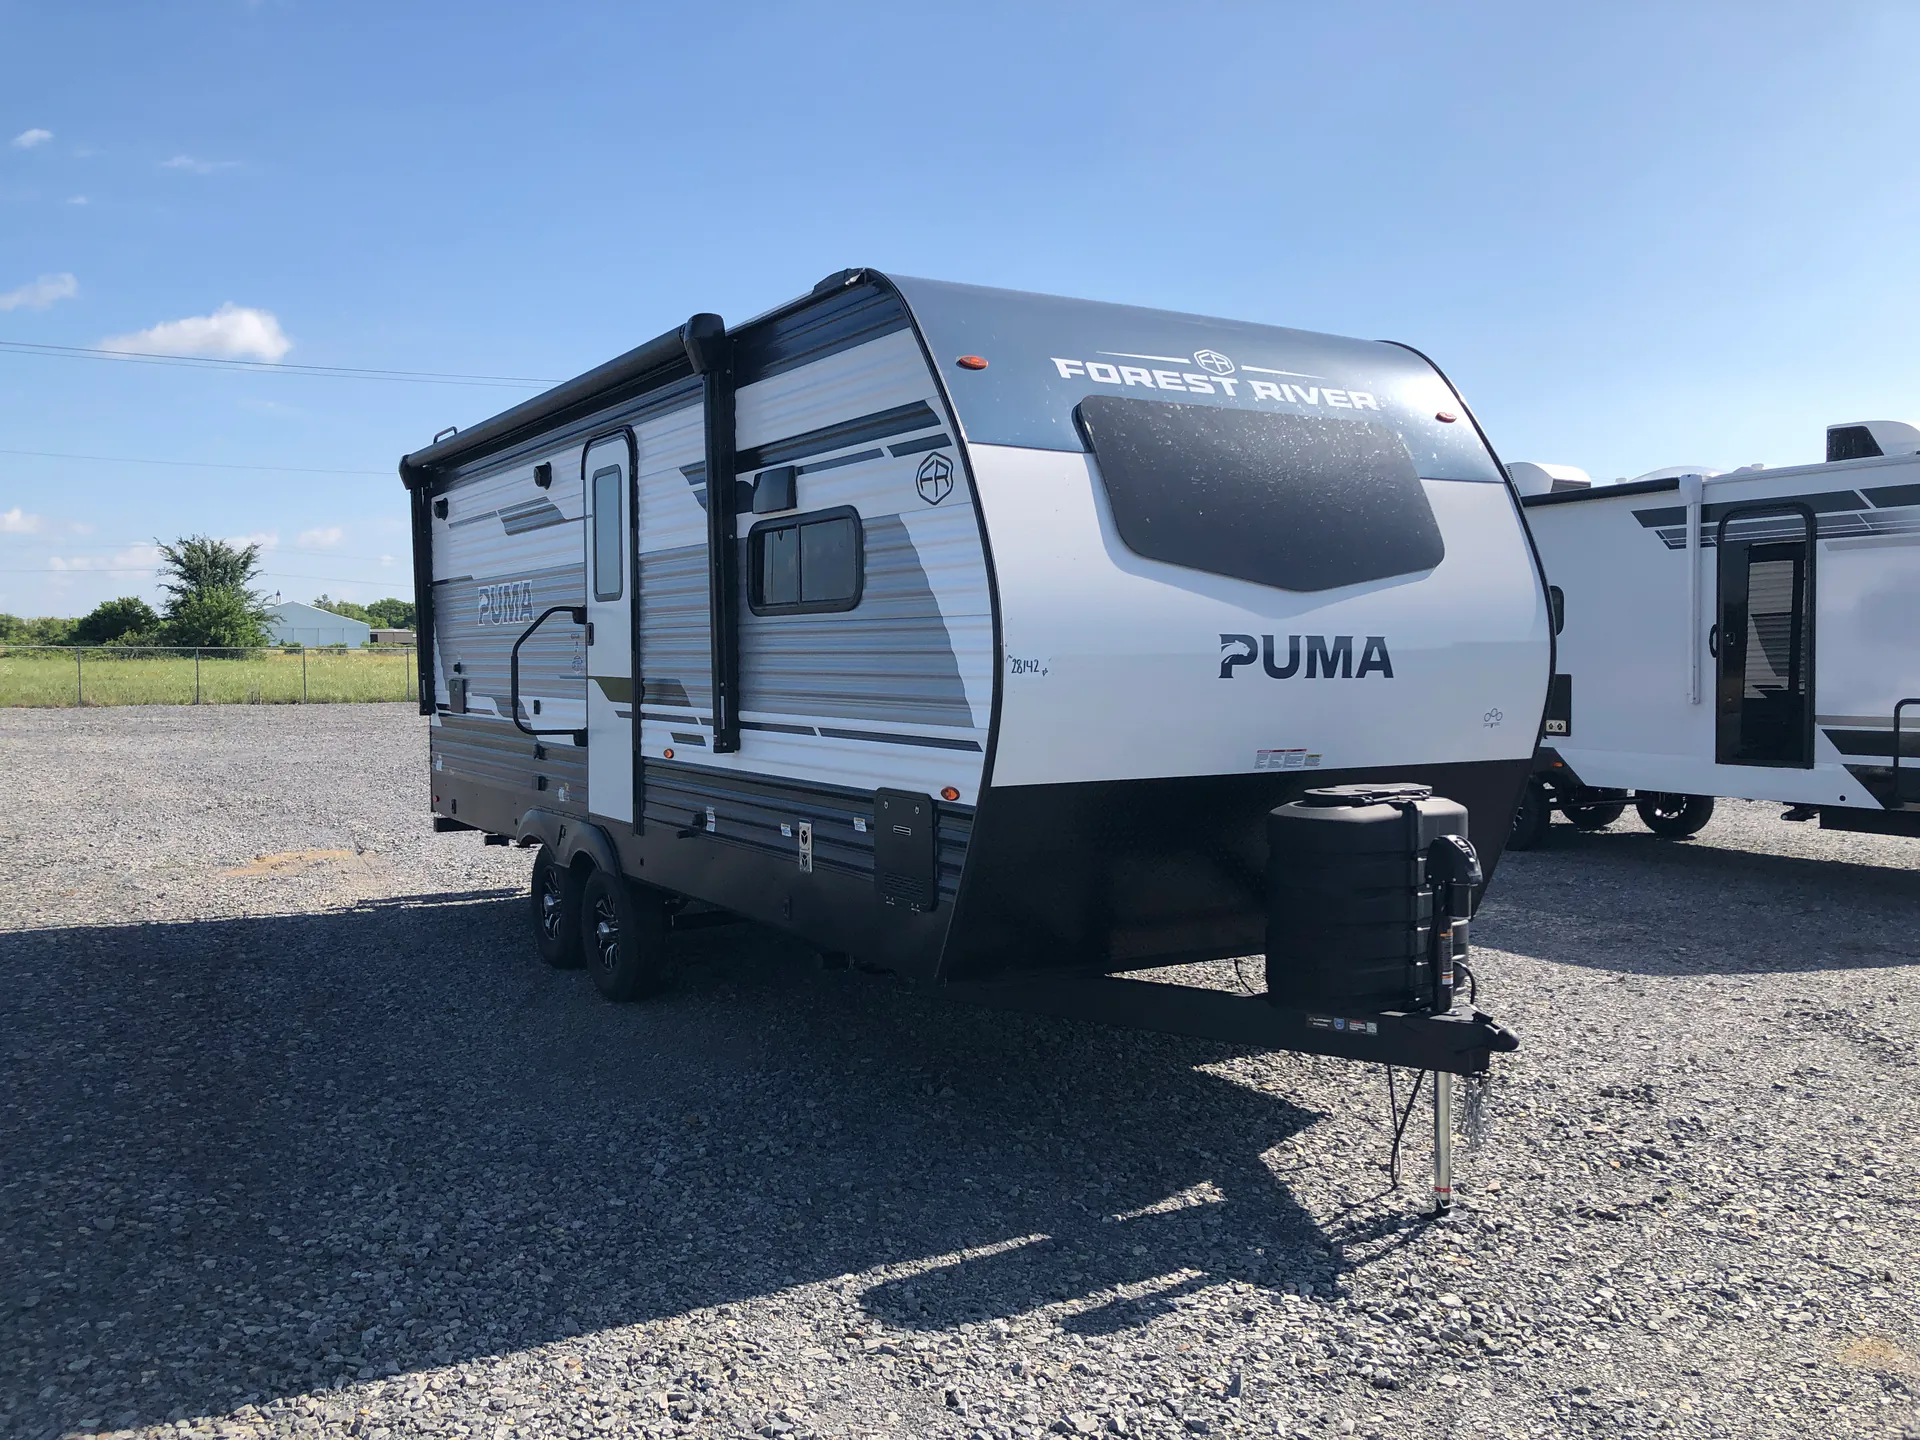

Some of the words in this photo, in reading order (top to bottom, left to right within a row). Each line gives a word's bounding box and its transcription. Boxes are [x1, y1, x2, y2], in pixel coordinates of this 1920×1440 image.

[1050, 357, 1239, 397] FOREST
[1247, 379, 1381, 411] RIVER
[478, 580, 536, 626] PUMA
[1011, 658, 1040, 674] 28142
[1218, 634, 1394, 679] PUMA
